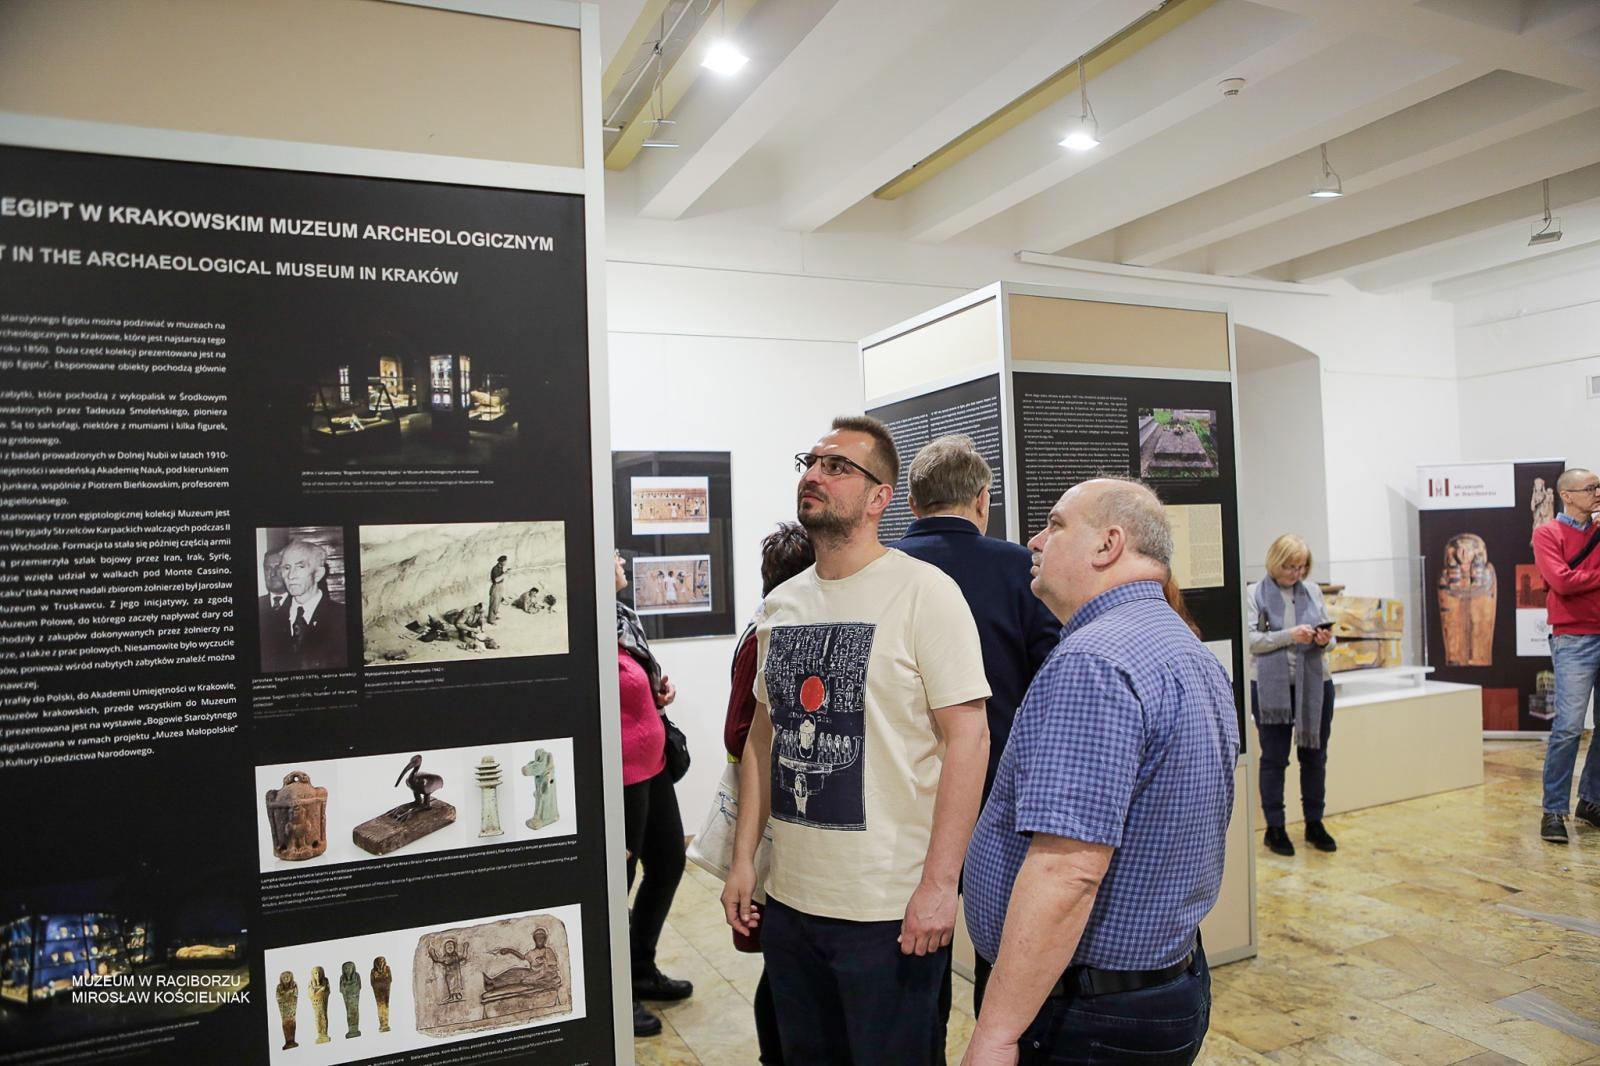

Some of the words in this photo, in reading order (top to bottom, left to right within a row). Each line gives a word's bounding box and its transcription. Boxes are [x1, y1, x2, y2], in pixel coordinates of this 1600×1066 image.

[1, 198, 73, 219] EGIPT
[80, 204, 102, 221] W
[109, 206, 263, 232] KRAKOWSKIM
[271, 218, 357, 238] MUZEUM
[363, 225, 553, 251] ARCHEOLOGICZNYM
[13, 246, 33, 262] IN
[40, 248, 81, 264] THE
[87, 251, 271, 274] ARCHAEOLOGICAL
[277, 262, 354, 279] MUSEUM
[360, 267, 376, 280] IN
[382, 264, 458, 284] KRAKÓW
[92, 318, 121, 326] można
[124, 319, 164, 328] podziwiać
[176, 320, 213, 329] muzeach
[80, 332, 122, 341] Krakowie,
[124, 333, 146, 341] które
[147, 334, 162, 343] jest
[164, 334, 206, 344] najstarszą
[208, 336, 225, 345] tego
[80, 347, 103, 356] część
[105, 347, 136, 357] kolekcji
[139, 348, 197, 358] prezentowana
[199, 350, 214, 359] jest
[118, 363, 149, 372] obiekty
[152, 364, 192, 373] pochodzą
[195, 365, 226, 374] głównie
[120, 392, 165, 401] wykopalisk
[180, 392, 227, 403] Środkowym
[86, 406, 125, 414] Tadeusza
[130, 407, 189, 417] Smoleńskiego,
[194, 408, 227, 416] pioniera
[38, 421, 80, 431] sarkofagi,
[176, 422, 195, 430] kilka
[198, 422, 227, 431] figurek,
[42, 451, 106, 461] prowadzonych
[117, 451, 145, 461] Dolnej
[146, 451, 168, 459] Nubii
[179, 451, 204, 459] latach
[206, 451, 228, 459] 1910-
[49, 466, 95, 475] wiedeńską
[97, 466, 139, 475] Akademię
[140, 466, 164, 474] Nauk,
[166, 466, 182, 475] pod
[41, 482, 80, 491] wspólnie
[88, 481, 122, 489] Piotrem
[124, 481, 180, 489] Bieńkowskim,
[182, 480, 229, 489] profesorem
[79, 511, 143, 521] egiptologicznej
[145, 510, 176, 519] kolekcji
[215, 510, 230, 518] jest
[53, 526, 95, 535] Strzelców
[96, 525, 143, 535] Karpackich
[144, 524, 190, 533] walczących
[191, 524, 224, 533] podczas
[62, 541, 103, 551] Formacja
[114, 540, 134, 548] stała
[136, 540, 148, 548] się
[149, 539, 179, 548] później
[180, 538, 209, 547] częścią
[74, 556, 96, 564] szlak
[100, 555, 132, 565] bojowy
[136, 556, 159, 564] przez
[164, 554, 182, 562] Iran,
[187, 553, 204, 562] Irak,
[209, 553, 231, 562] Syrię,
[58, 572, 86, 580] udział
[103, 570, 138, 578] walkach
[143, 569, 160, 578] pod
[165, 568, 192, 576] Monte
[197, 567, 231, 575] Cassino.
[80, 585, 106, 594] nadali
[108, 584, 143, 593] zbiorom
[144, 583, 184, 592] żołnierze)
[186, 582, 197, 591] był
[198, 581, 232, 591] Jarosław
[54, 601, 105, 610] Truskawcu.
[120, 599, 139, 609] jego
[144, 598, 188, 607] inicjatywy,
[208, 596, 232, 605] zgodą
[40, 616, 75, 626] Polowe,
[93, 614, 126, 624] którego
[129, 613, 158, 622] zaczęły
[161, 611, 199, 621] napływać
[202, 610, 220, 619] dary
[48, 631, 87, 642] zakupów
[90, 628, 154, 639] dokonywanych
[158, 628, 180, 637] przez
[184, 625, 220, 634] żołnierzy
[58, 649, 77, 657] prac
[79, 644, 122, 656] polowych.
[124, 641, 178, 652] Niesamowite
[180, 640, 197, 650] było
[198, 638, 234, 649] wyczucie
[65, 661, 92, 670] wśród
[94, 658, 133, 669] nabytych
[136, 656, 174, 667] zabytków
[176, 654, 206, 663] znaleźć
[208, 653, 235, 661] można
[47, 693, 75, 702] Polski,
[90, 689, 130, 699] Akademii
[132, 685, 186, 696] Umiejętności
[197, 681, 236, 692] Krakowie,
[43, 706, 99, 717] krakowskich,
[104, 703, 134, 714] przede
[138, 699, 181, 711] wszystkim
[201, 695, 236, 705] Muzeum
[72, 721, 87, 732] jest
[102, 717, 142, 729] wystawie
[184, 709, 237, 721] Starożytnego
[78, 735, 111, 745] ramach
[114, 731, 149, 743] projektu
[44, 751, 96, 763] Dziedzictwa
[98, 747, 154, 759] Narodowego.
